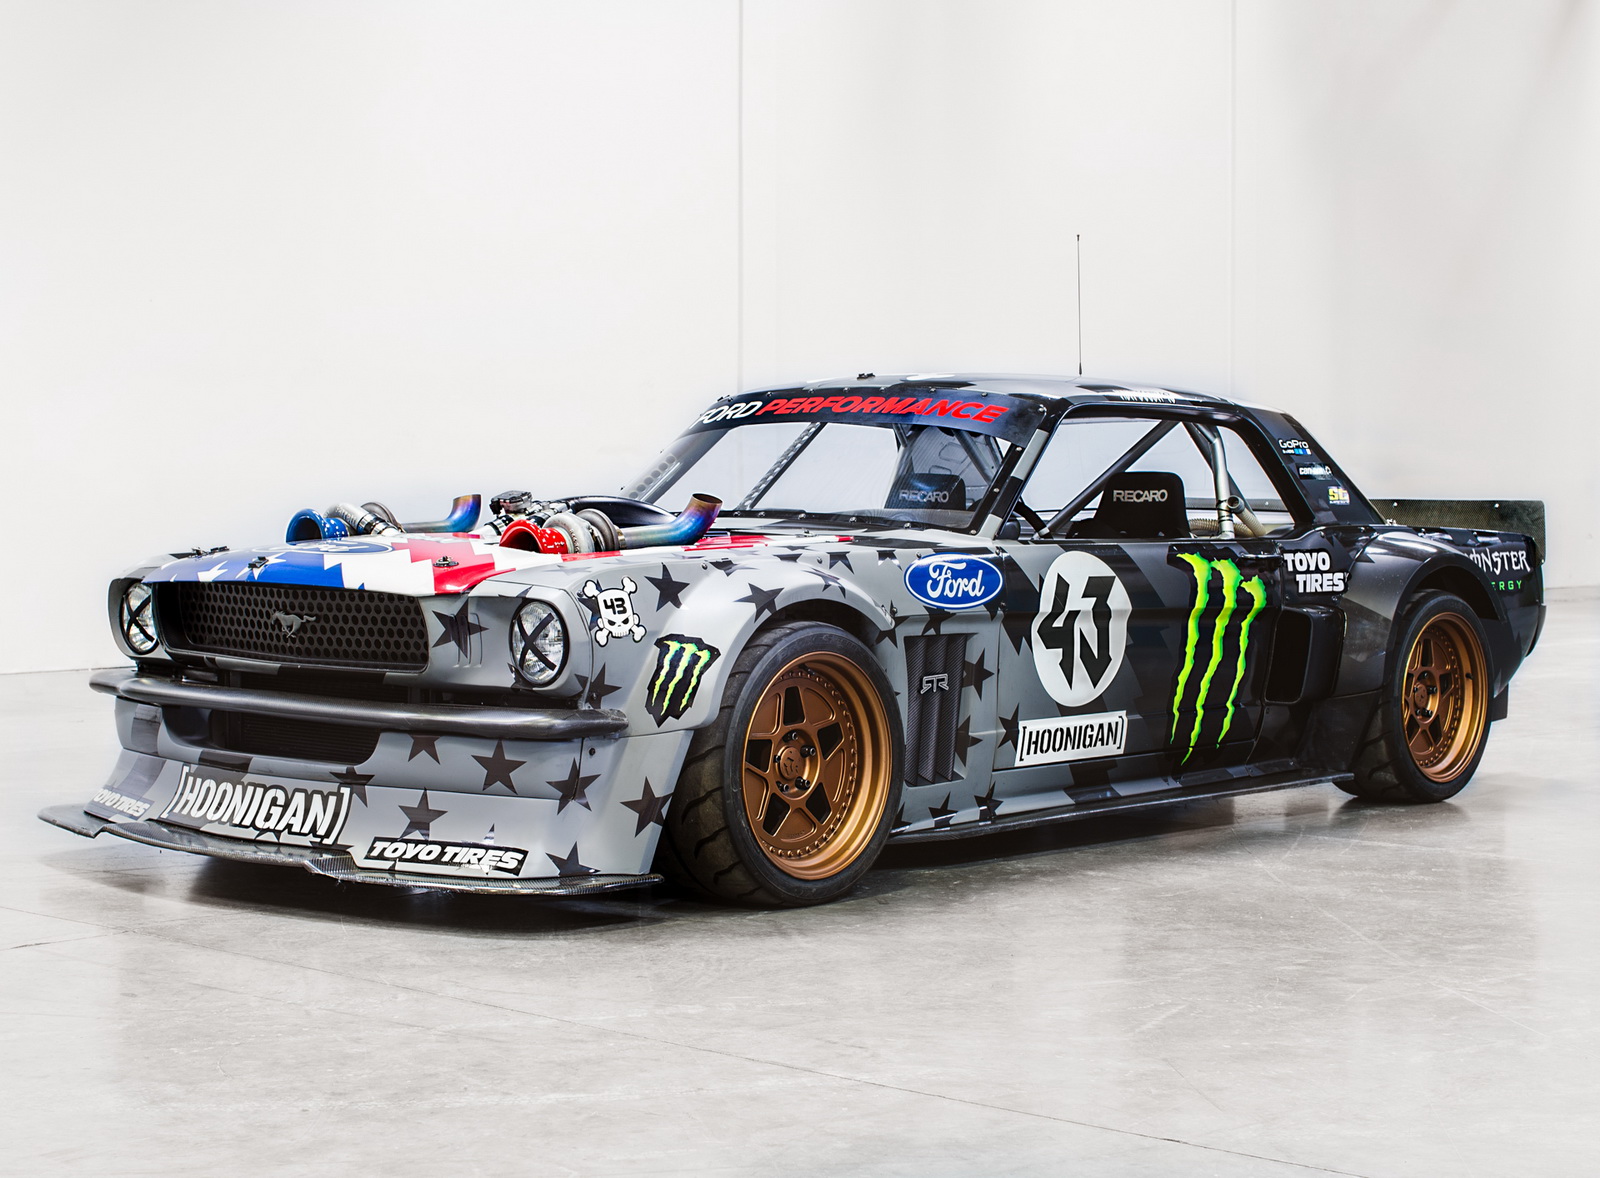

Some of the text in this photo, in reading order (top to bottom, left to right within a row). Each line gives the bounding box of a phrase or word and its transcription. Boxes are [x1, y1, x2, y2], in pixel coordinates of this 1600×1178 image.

[689, 396, 1010, 430] FORD PERFORMANCE
[1278, 439, 1309, 449] GoPro
[898, 489, 950, 503] RECARO
[1112, 489, 1169, 503] RECARO
[1283, 551, 1331, 572] TOYO
[1465, 547, 1531, 576] ONSTER
[926, 562, 985, 599] Ford
[1295, 572, 1345, 594] TIRES
[602, 597, 628, 615] 43
[94, 788, 151, 817] OYO TIRES
[369, 841, 525, 870] TOYO TIRES
